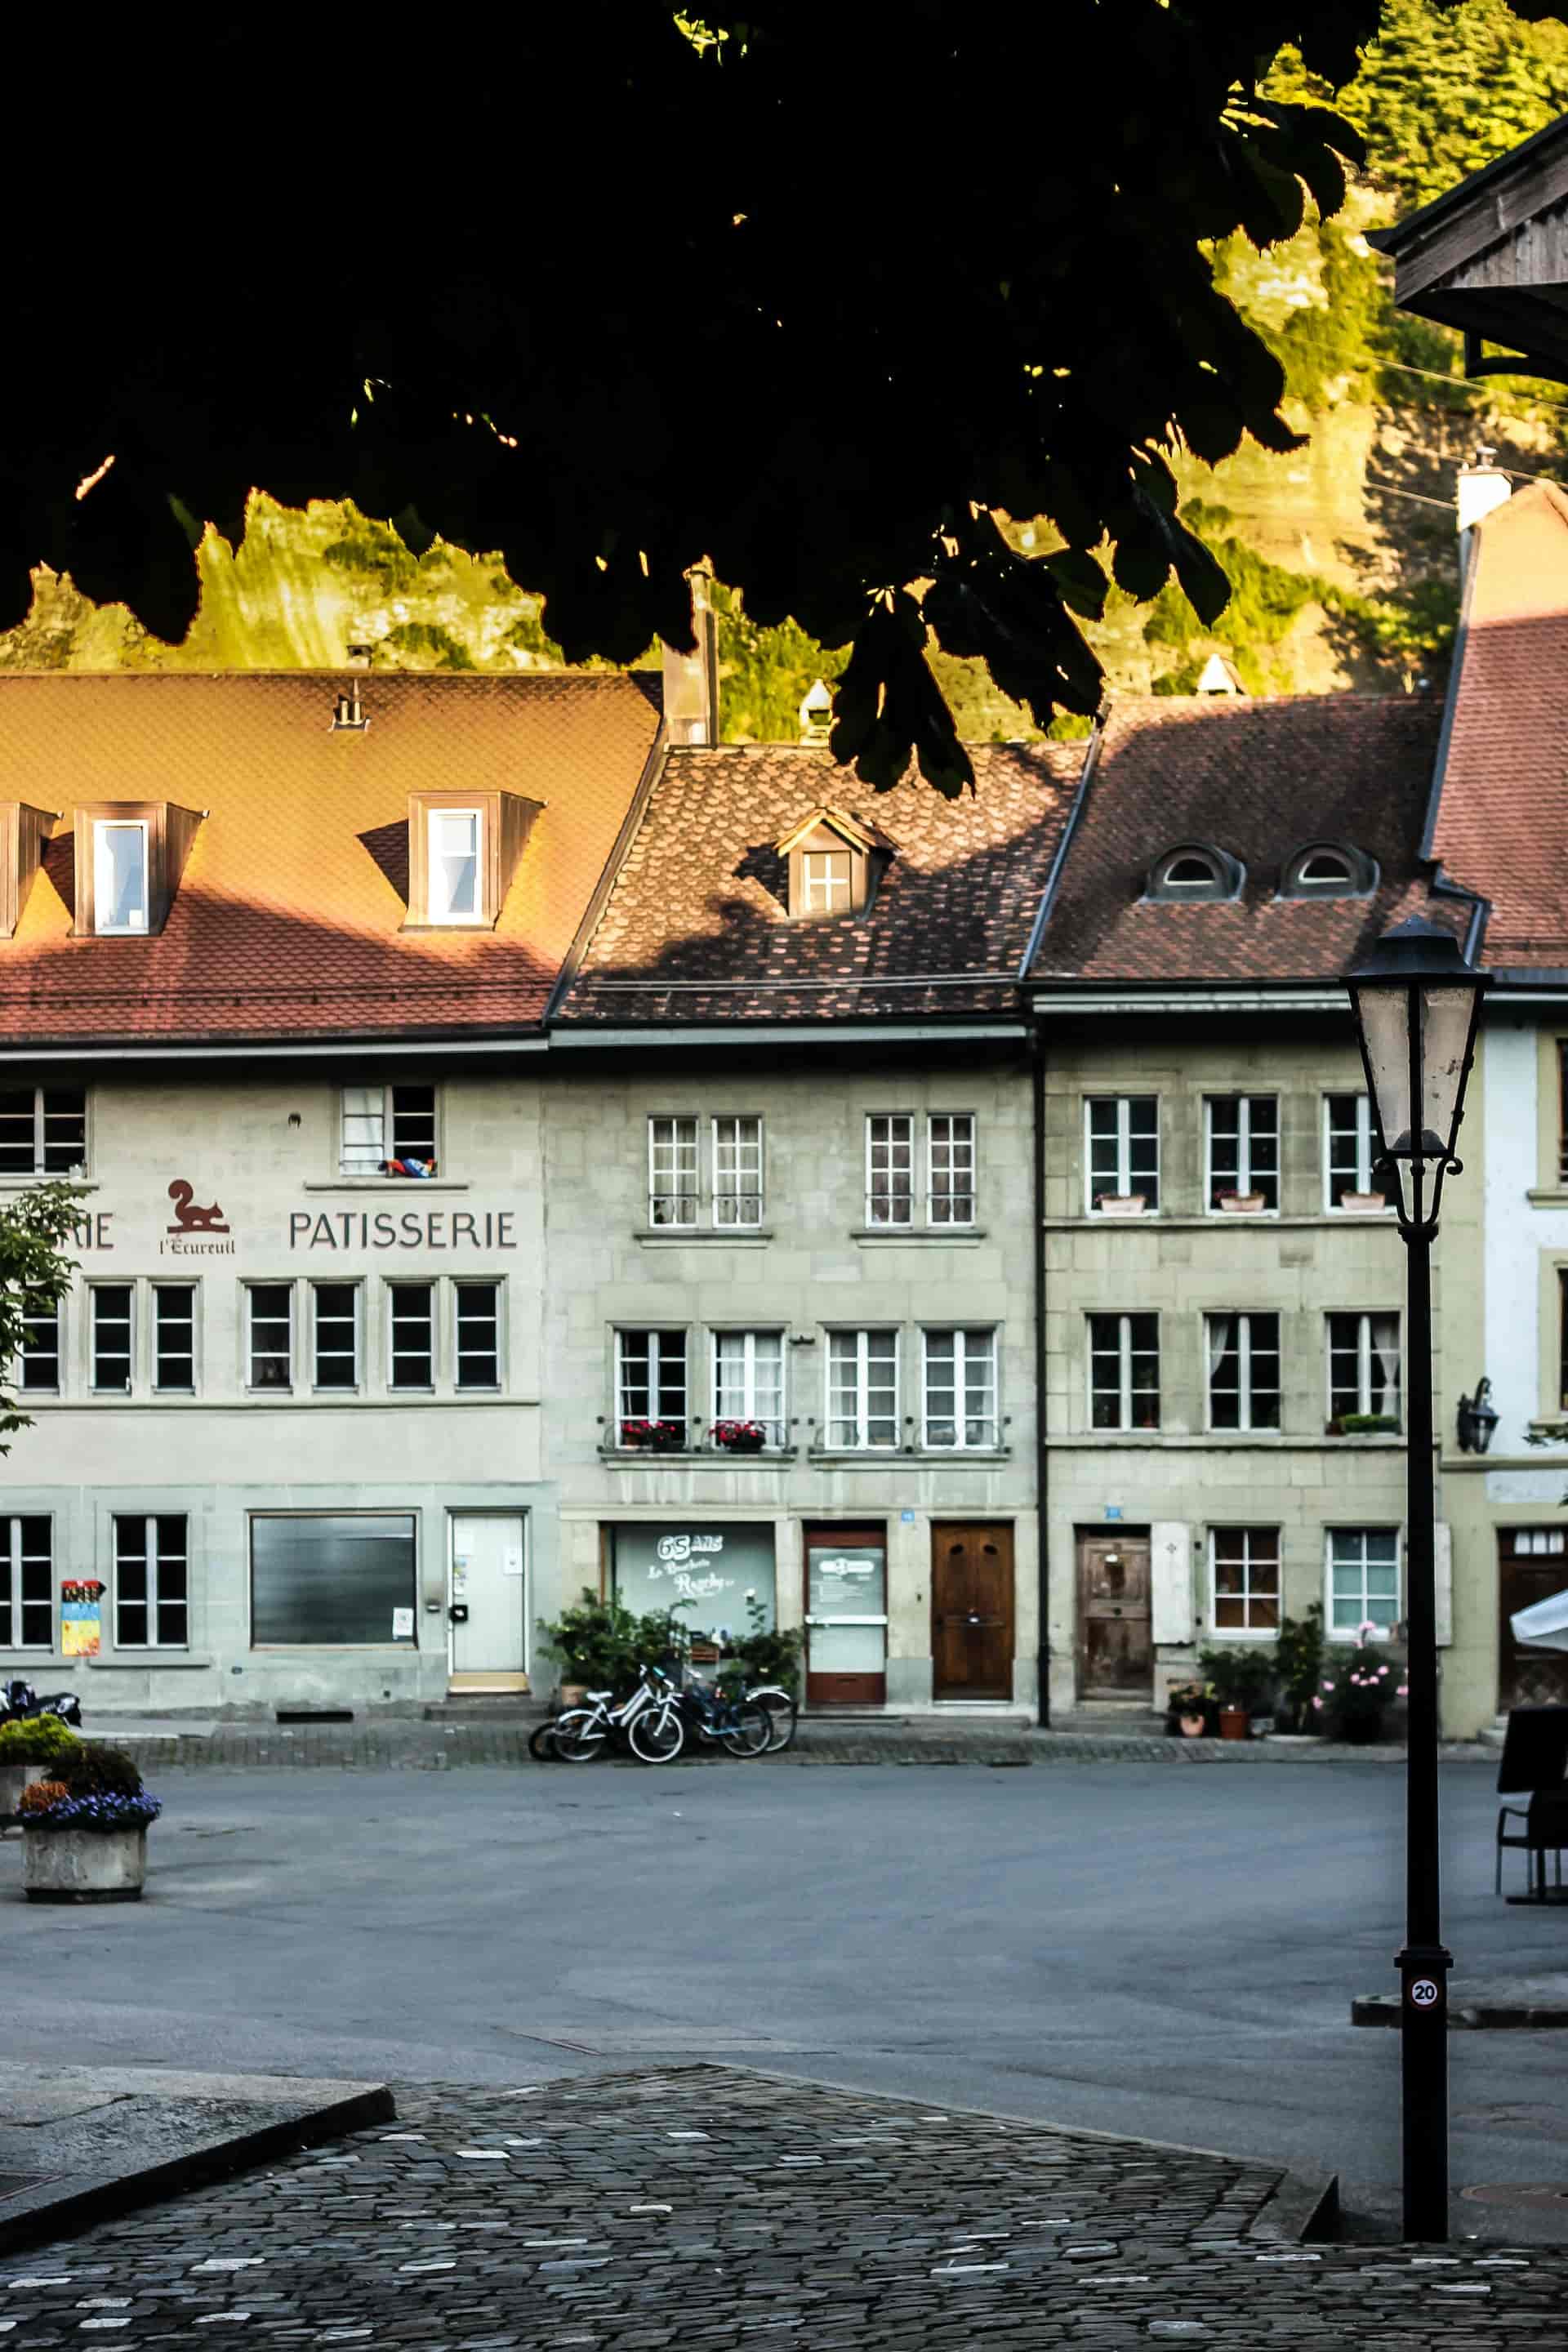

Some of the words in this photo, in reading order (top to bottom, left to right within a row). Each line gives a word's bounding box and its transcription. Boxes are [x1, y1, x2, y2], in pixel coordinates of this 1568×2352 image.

[290, 1212, 518, 1250] PATISSERIE
[657, 1535, 691, 1561] 65
[1414, 1984, 1435, 2000] 20
